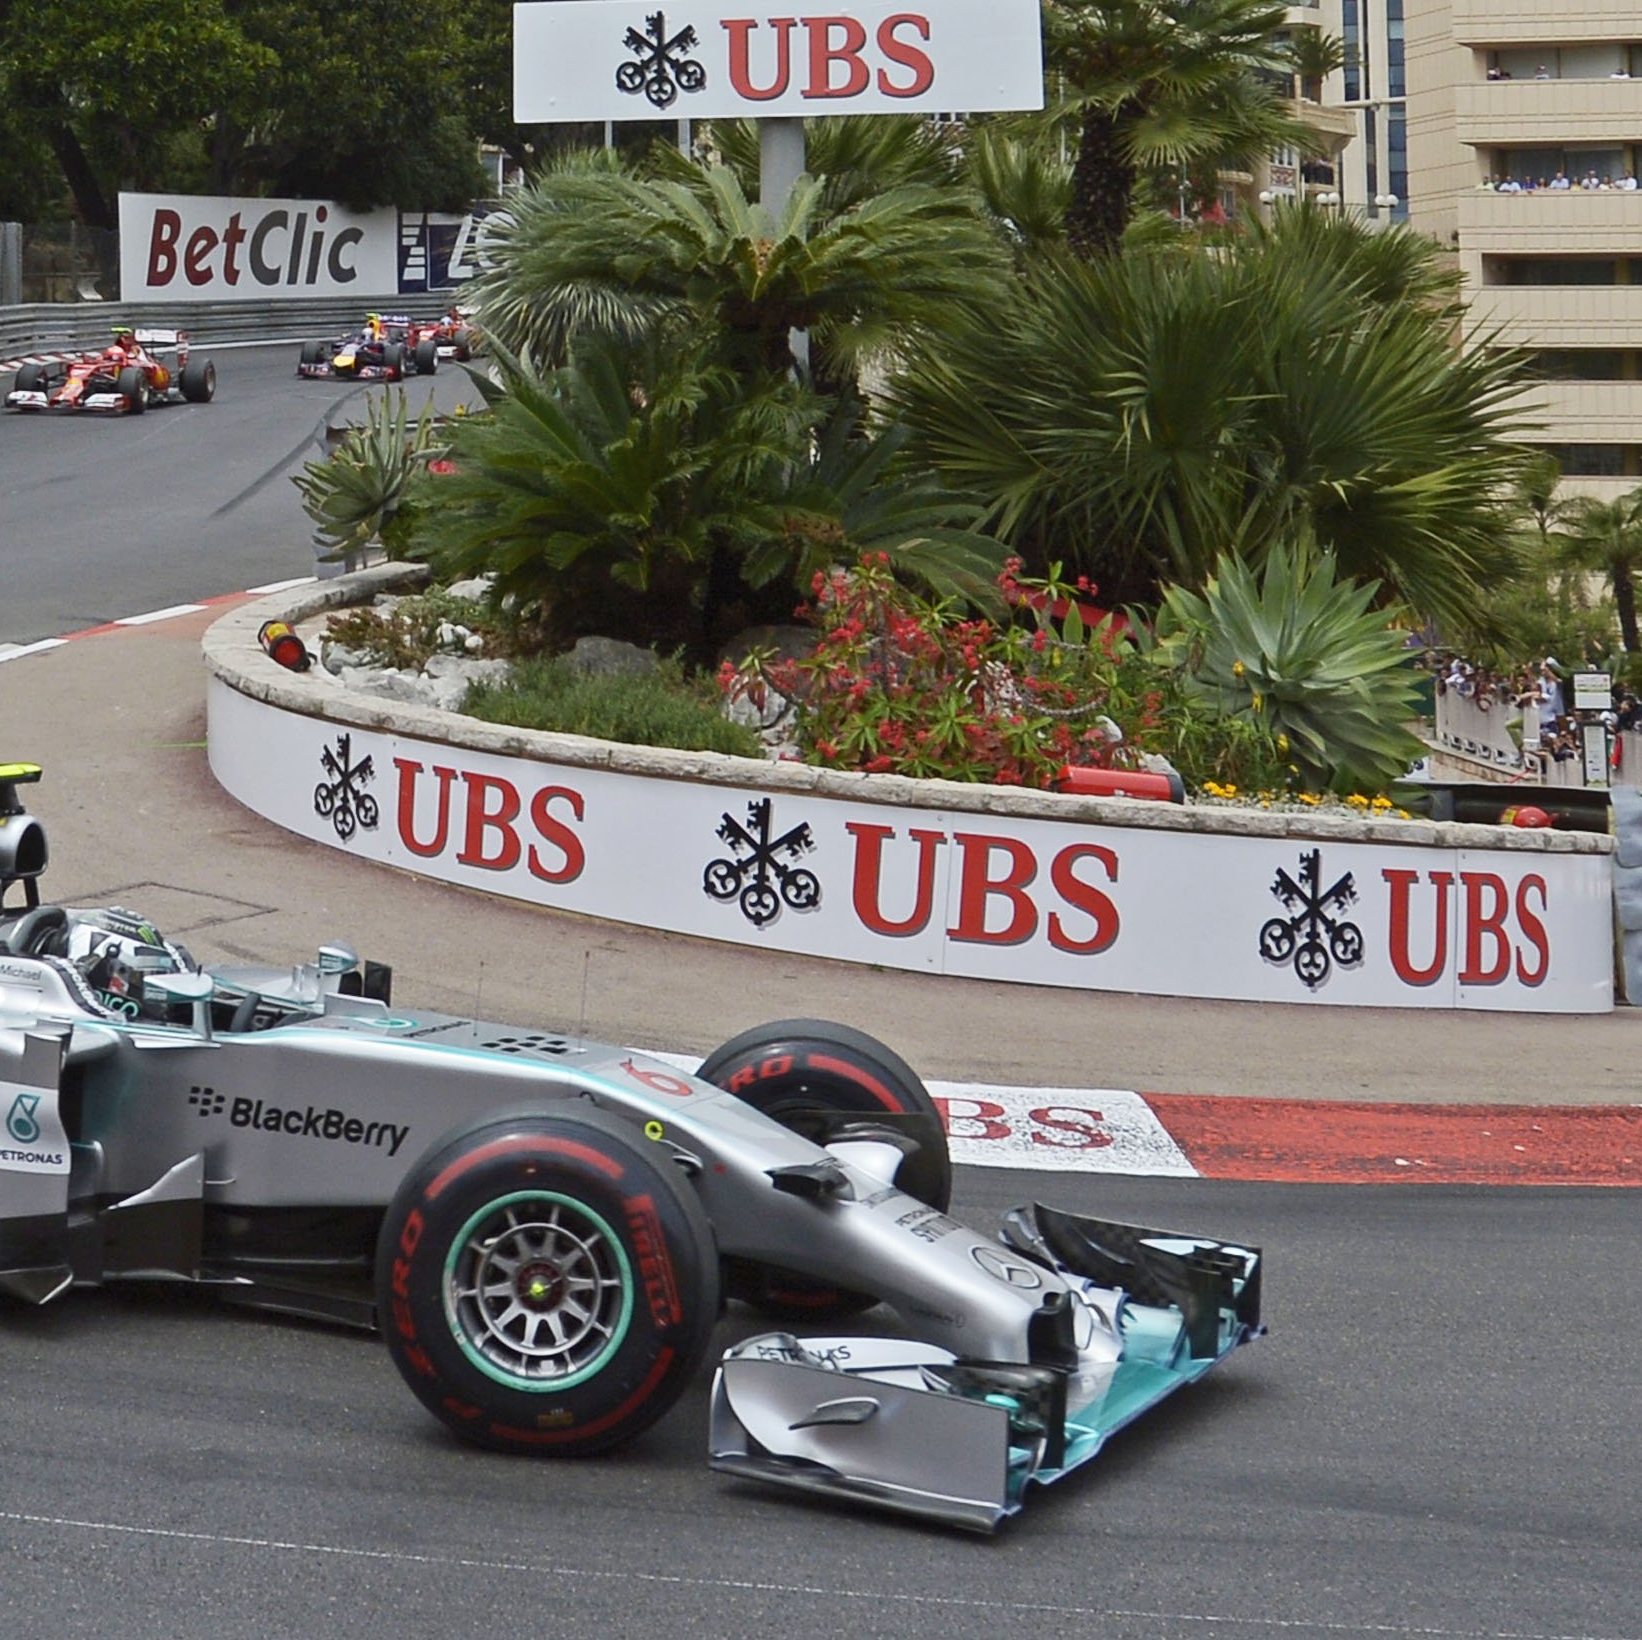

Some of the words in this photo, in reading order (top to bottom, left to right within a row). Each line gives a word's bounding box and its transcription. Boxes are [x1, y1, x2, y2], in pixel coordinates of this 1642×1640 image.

[720, 13, 934, 101] UBS
[146, 205, 364, 288] BetClic
[393, 757, 586, 884] UBS
[846, 821, 1119, 955] UBS
[1382, 869, 1549, 986] UBS
[230, 1097, 410, 1157] BlackBerry
[935, 1098, 1114, 1148] BS
